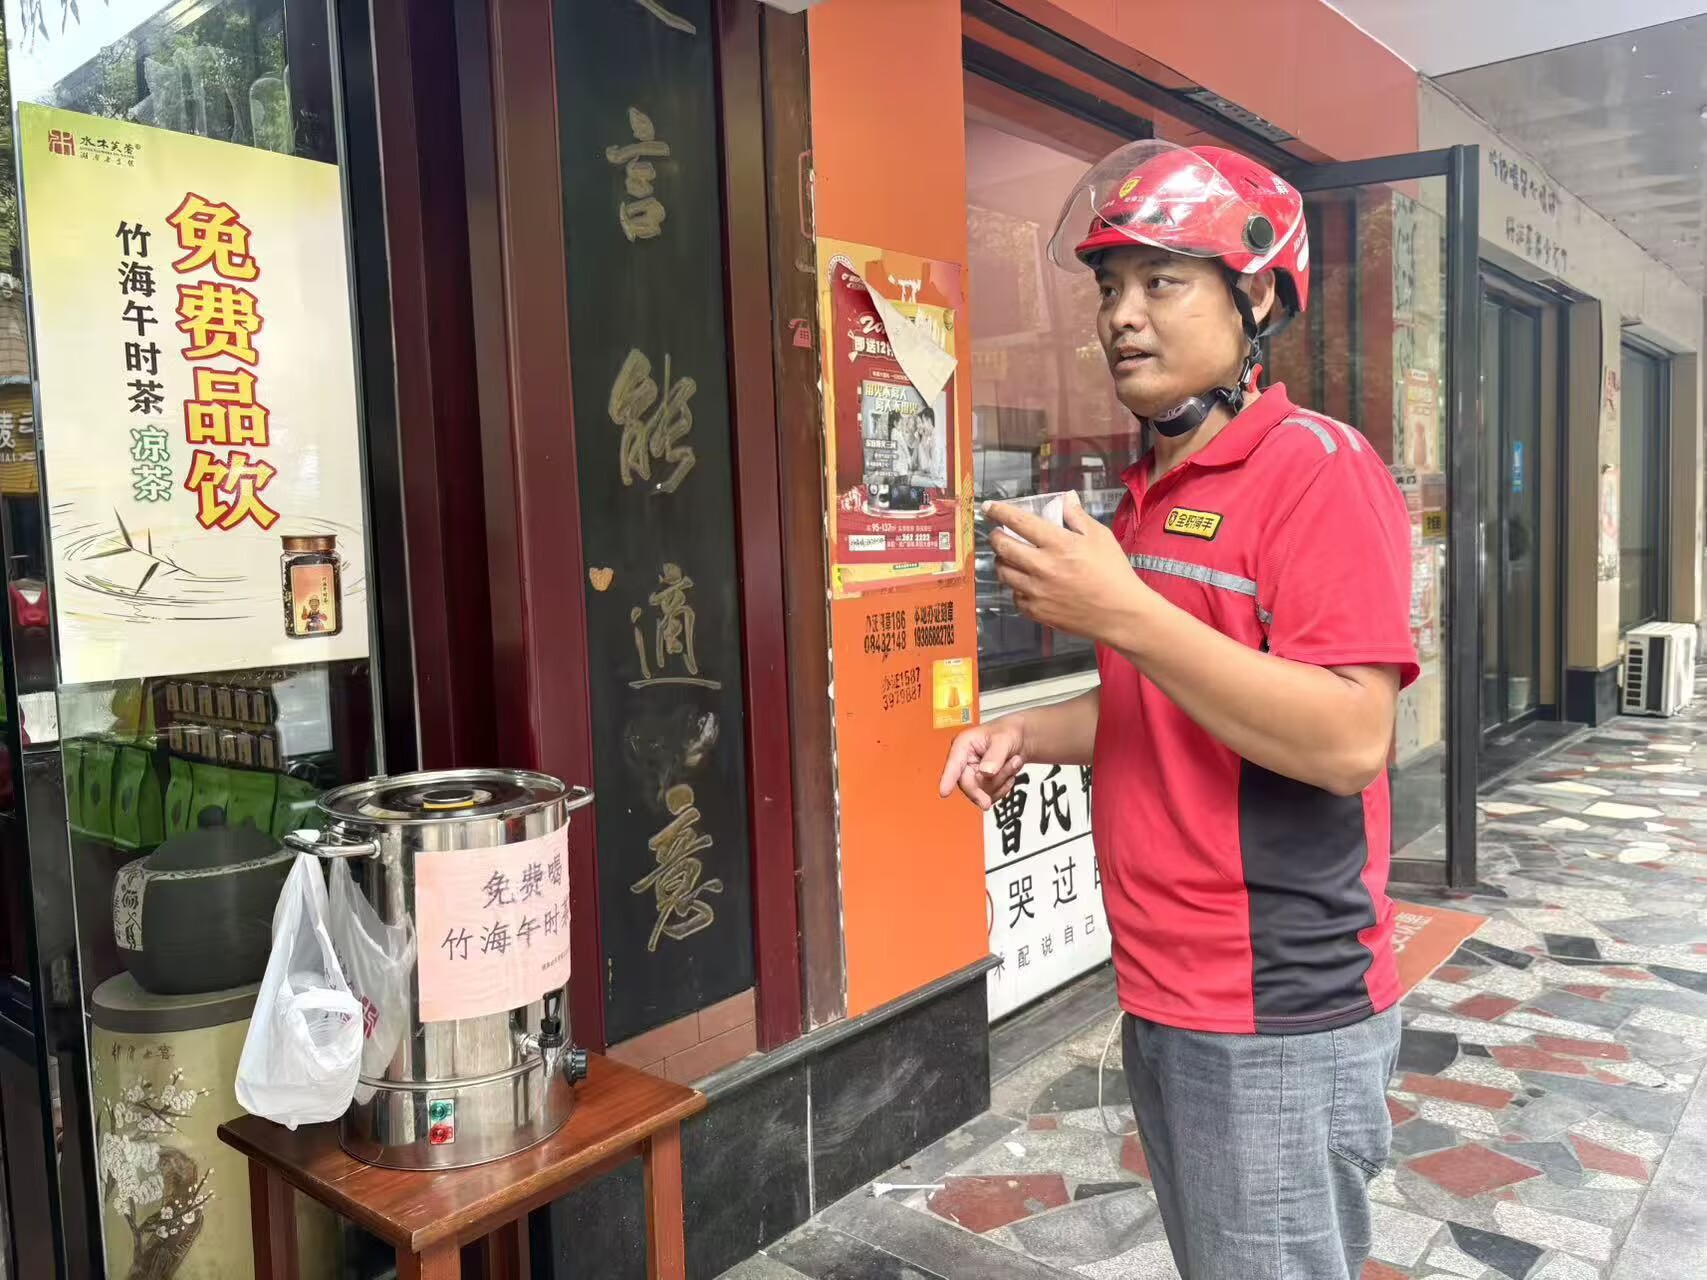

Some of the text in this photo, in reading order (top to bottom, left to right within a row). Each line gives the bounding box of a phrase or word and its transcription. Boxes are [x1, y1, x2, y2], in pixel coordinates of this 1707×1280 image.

[115, 220, 166, 415] 竹海午时茶
[165, 192, 281, 531] 免费品饮
[129, 424, 174, 502] 凉茶
[481, 852, 563, 909] 免费喝
[1008, 855, 1101, 929] 哭过
